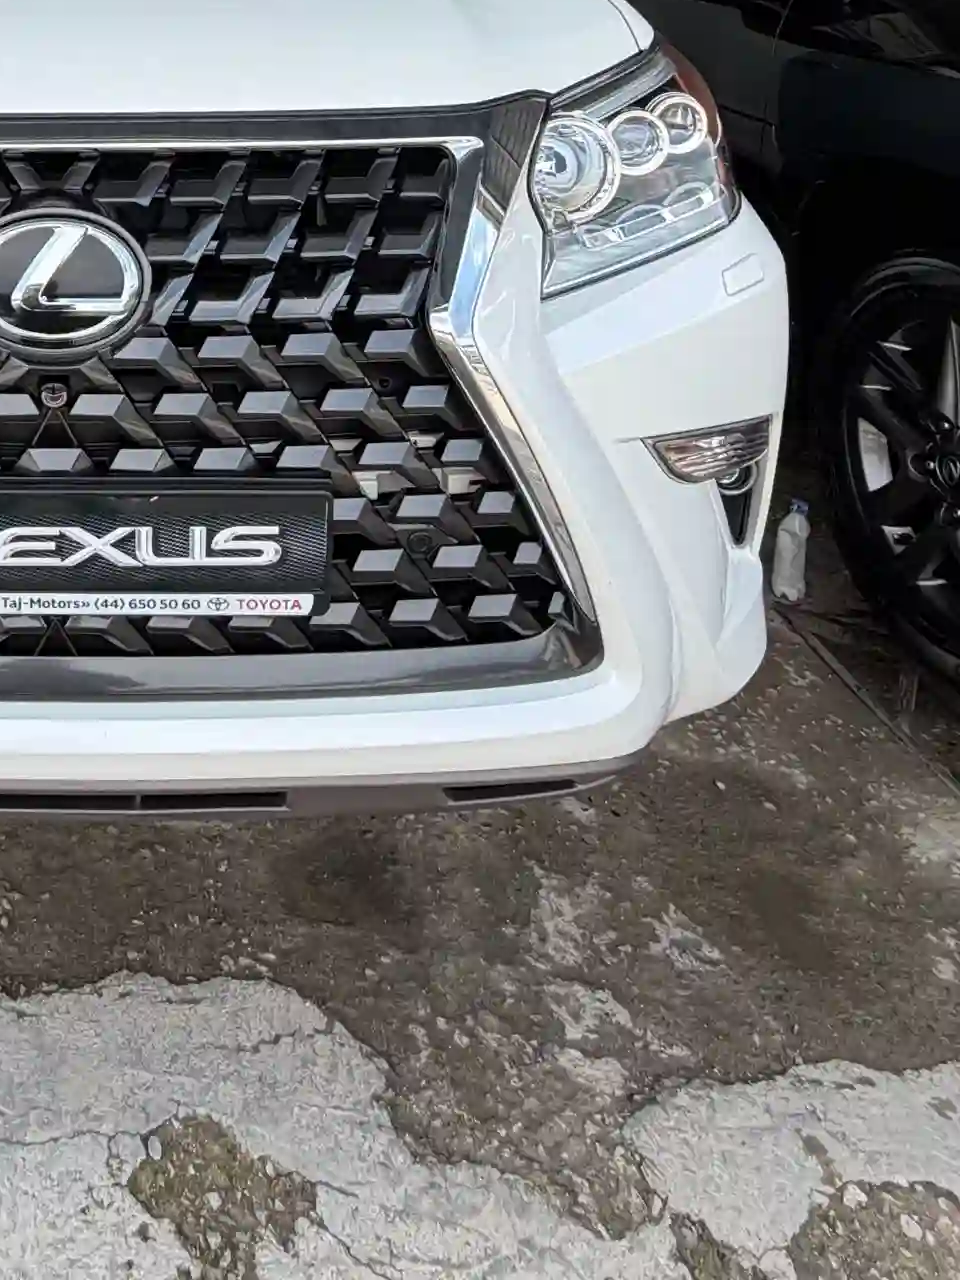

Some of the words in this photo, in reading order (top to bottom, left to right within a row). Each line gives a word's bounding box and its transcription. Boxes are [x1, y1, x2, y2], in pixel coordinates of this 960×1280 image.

[94, 599, 125, 612] (44)
[128, 599, 157, 610] 650
[159, 599, 178, 610] 50
[181, 599, 201, 610] 60
[236, 599, 302, 611] TOYOTA
